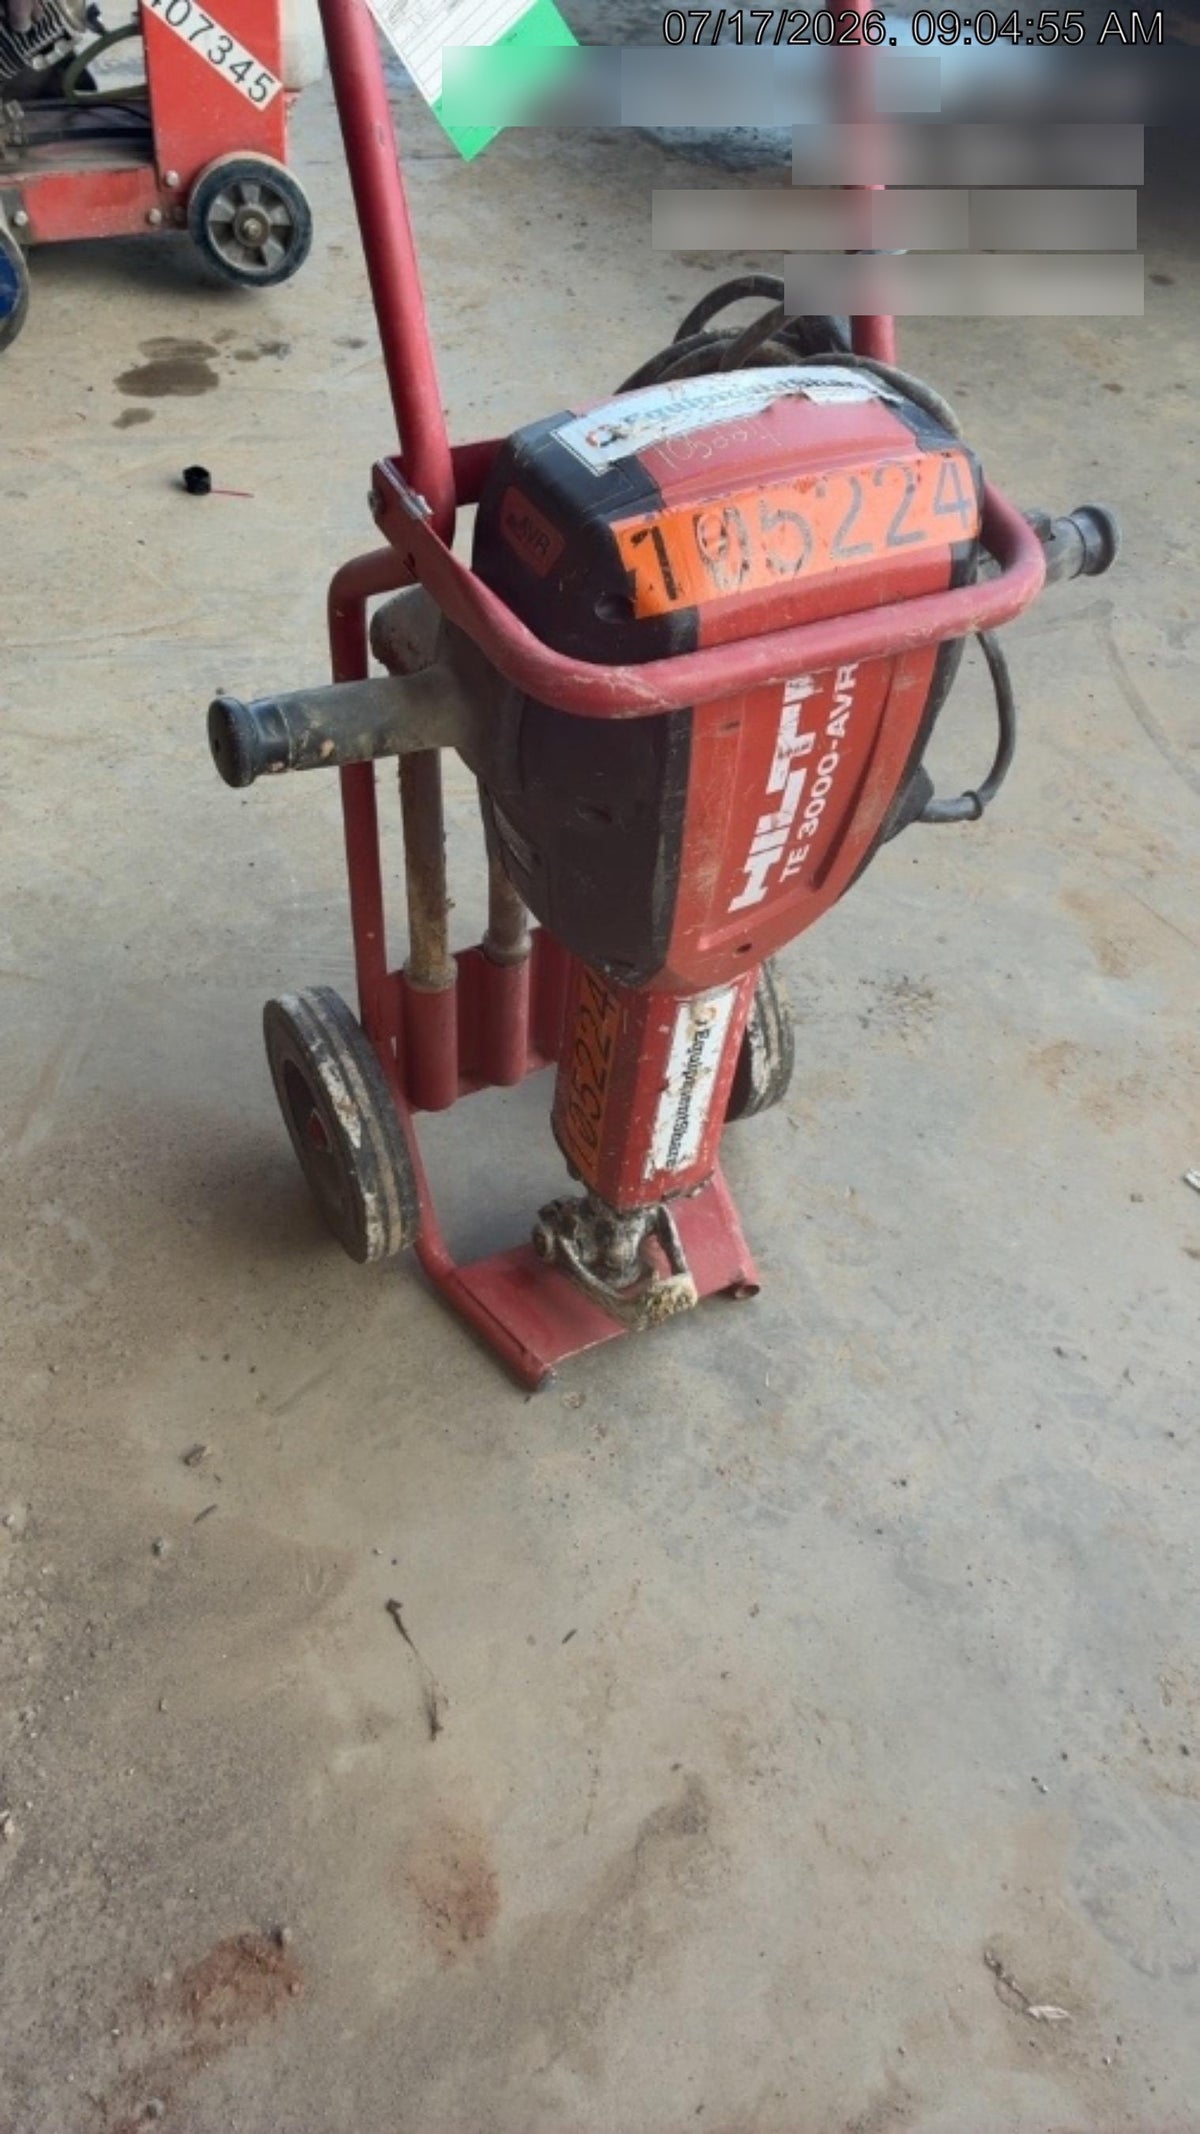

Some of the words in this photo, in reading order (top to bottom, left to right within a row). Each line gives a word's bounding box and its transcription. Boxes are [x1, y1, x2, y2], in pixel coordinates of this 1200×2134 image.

[151, 0, 275, 103] 07345
[630, 459, 974, 601] 105224
[727, 674, 817, 914] HILTI
[779, 844, 811, 883] TE
[797, 663, 859, 841] 3000-AVR
